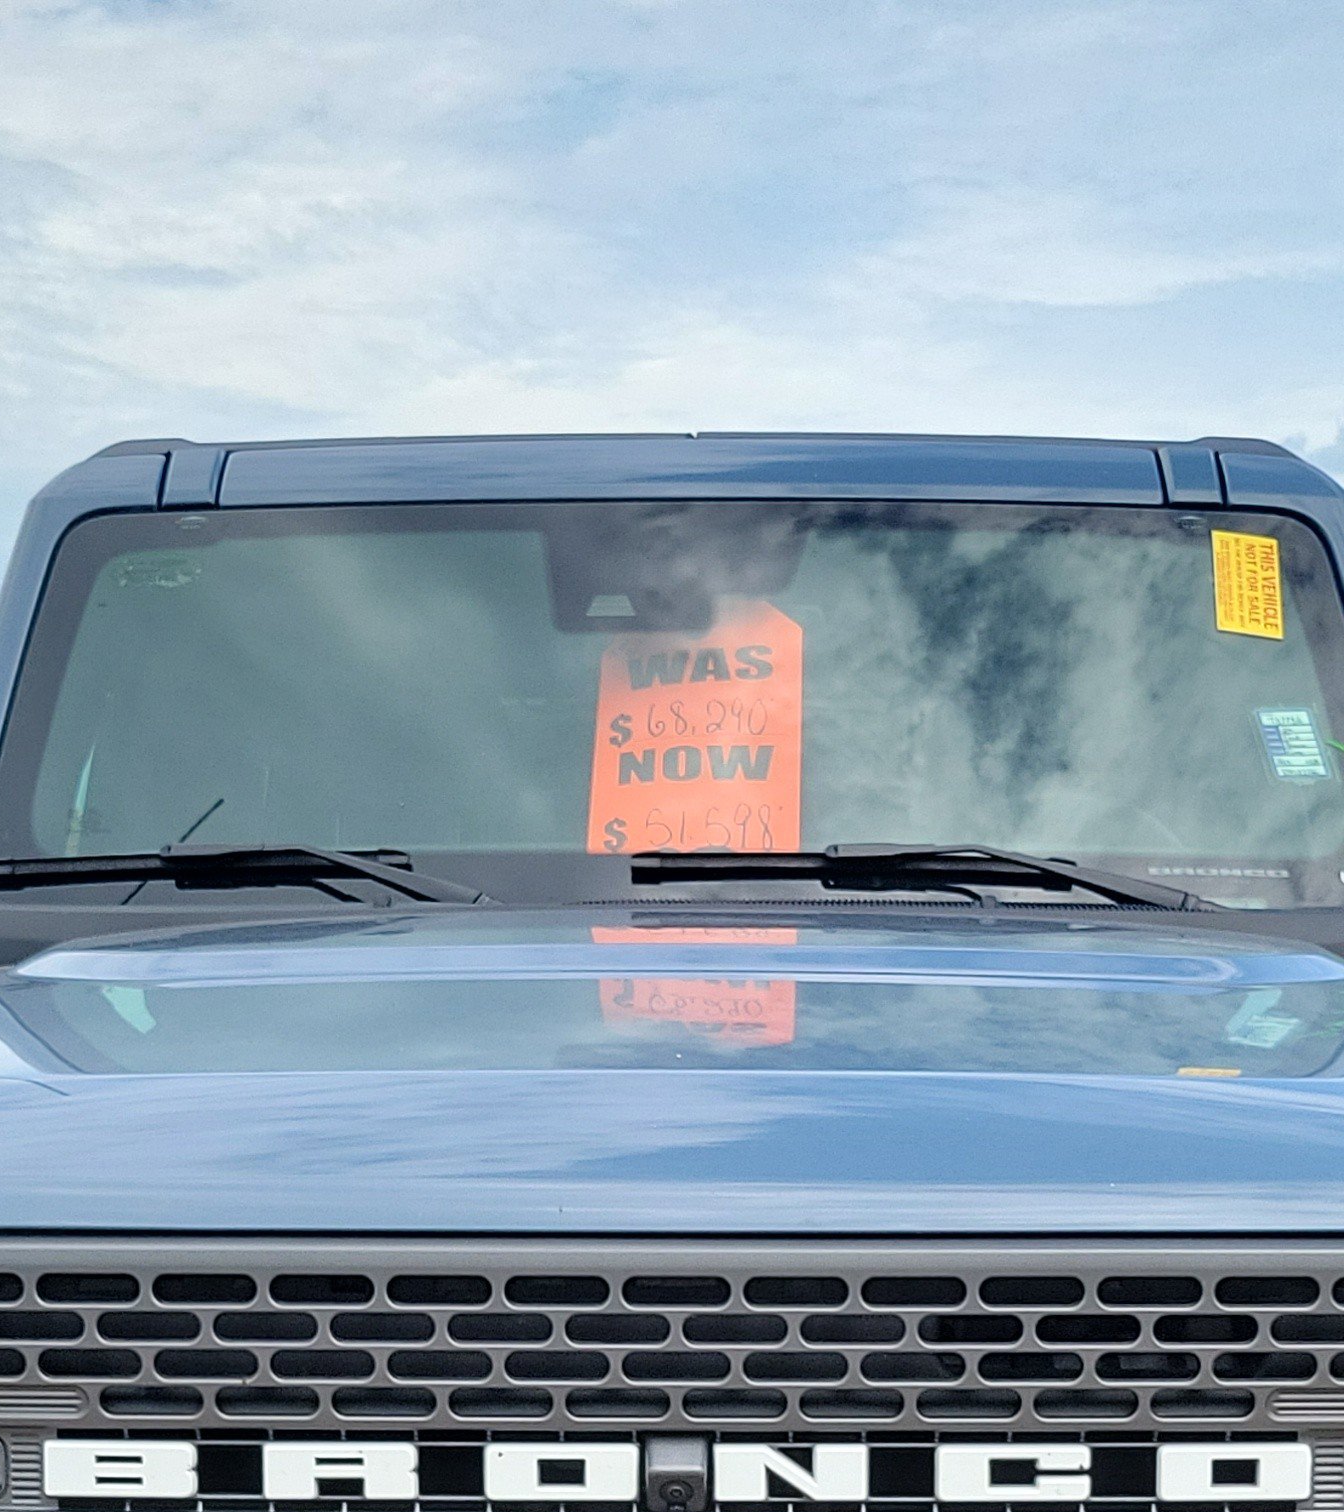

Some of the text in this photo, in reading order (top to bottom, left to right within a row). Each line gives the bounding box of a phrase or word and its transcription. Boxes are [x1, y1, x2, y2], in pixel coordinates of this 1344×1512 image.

[1245, 543, 1258, 567] NOT
[1258, 543, 1279, 631] THIS VEHICLE
[1247, 595, 1261, 626] SALE
[628, 645, 773, 690] WAS
[609, 713, 633, 748] $
[618, 745, 774, 785] NOW
[603, 817, 628, 852] $
[42, 1439, 1312, 1502] BRONCO
